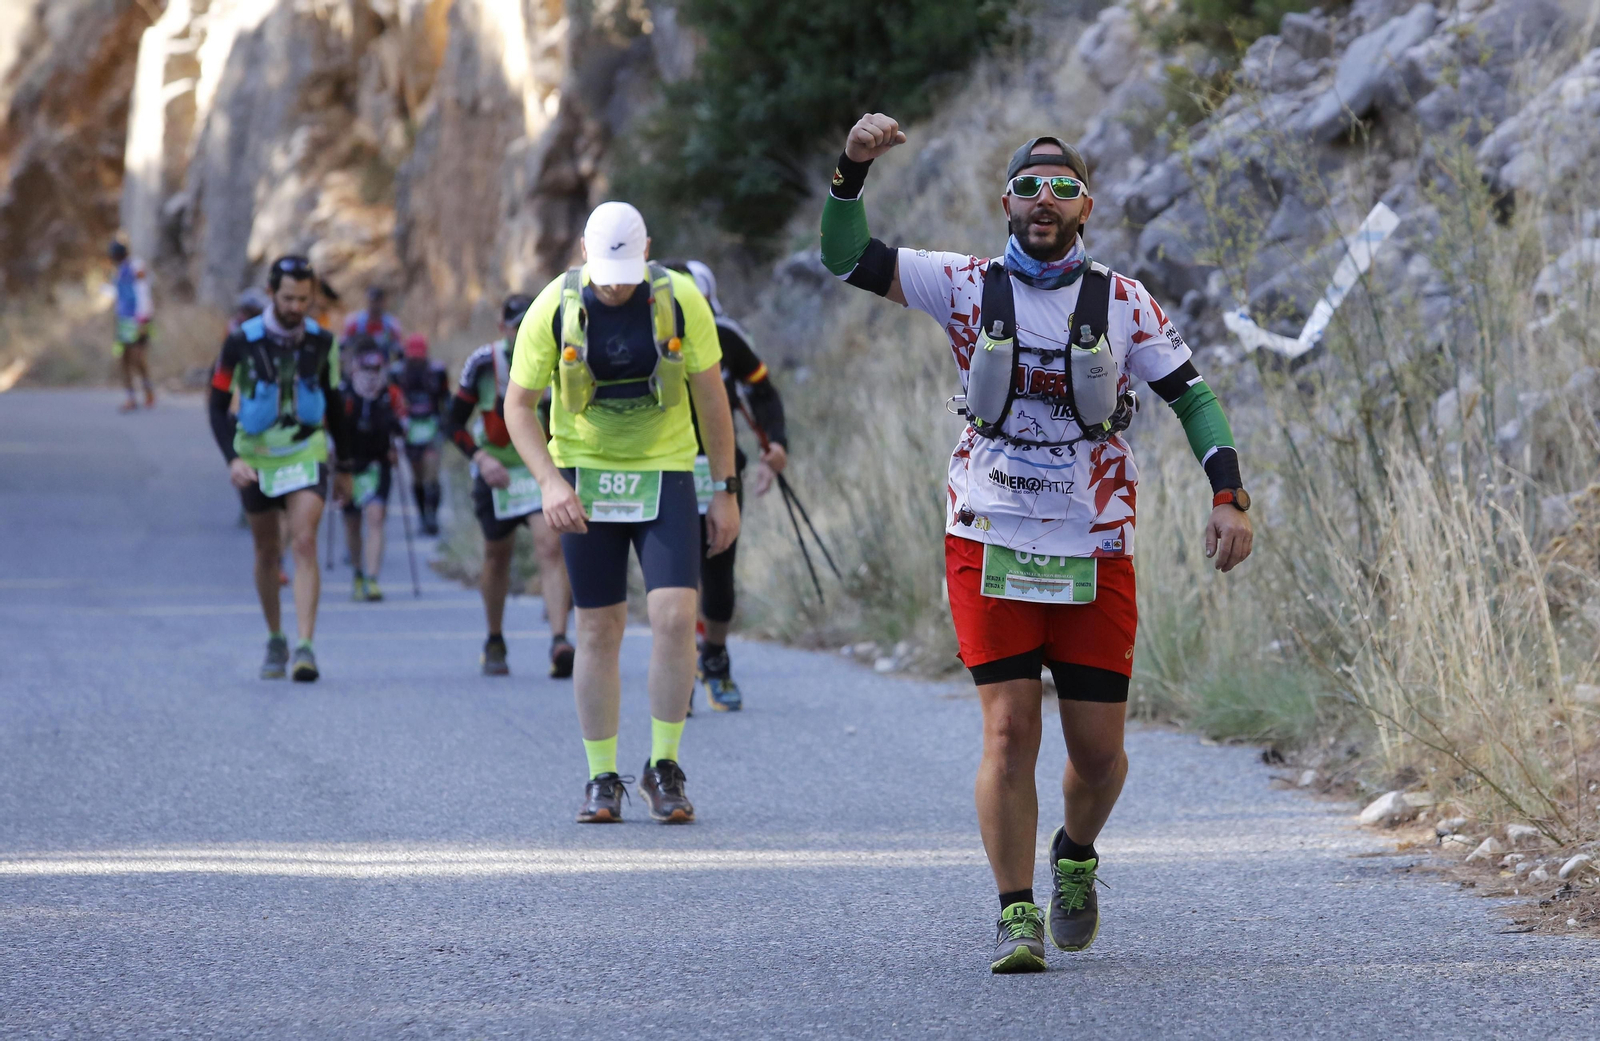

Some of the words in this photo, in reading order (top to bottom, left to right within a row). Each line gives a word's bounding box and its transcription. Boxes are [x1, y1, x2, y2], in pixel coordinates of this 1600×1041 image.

[1030, 367, 1068, 397] BER
[1052, 403, 1075, 419] TR
[598, 472, 642, 495] 587
